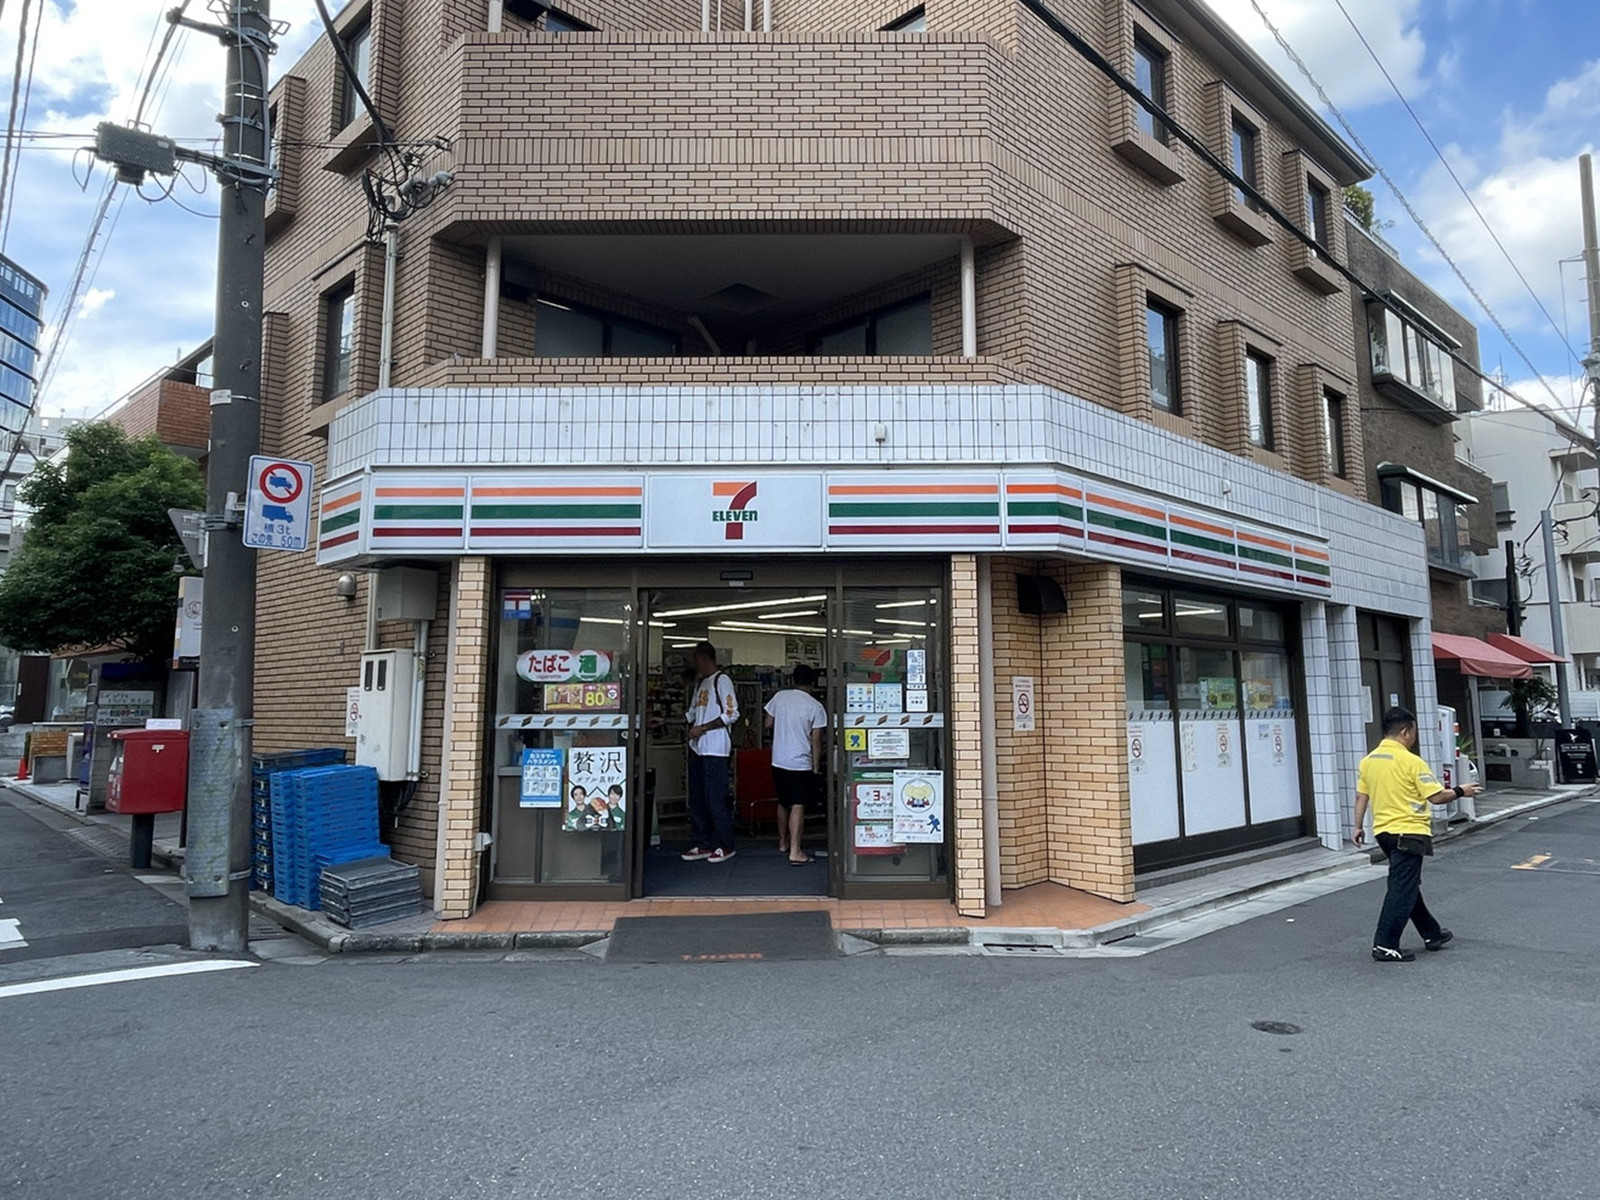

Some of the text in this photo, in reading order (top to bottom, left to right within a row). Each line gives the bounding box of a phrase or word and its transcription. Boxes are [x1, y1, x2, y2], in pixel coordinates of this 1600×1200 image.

[713, 481, 757, 540] 7
[528, 654, 570, 673] たばこ
[573, 751, 622, 775] 贅沢
